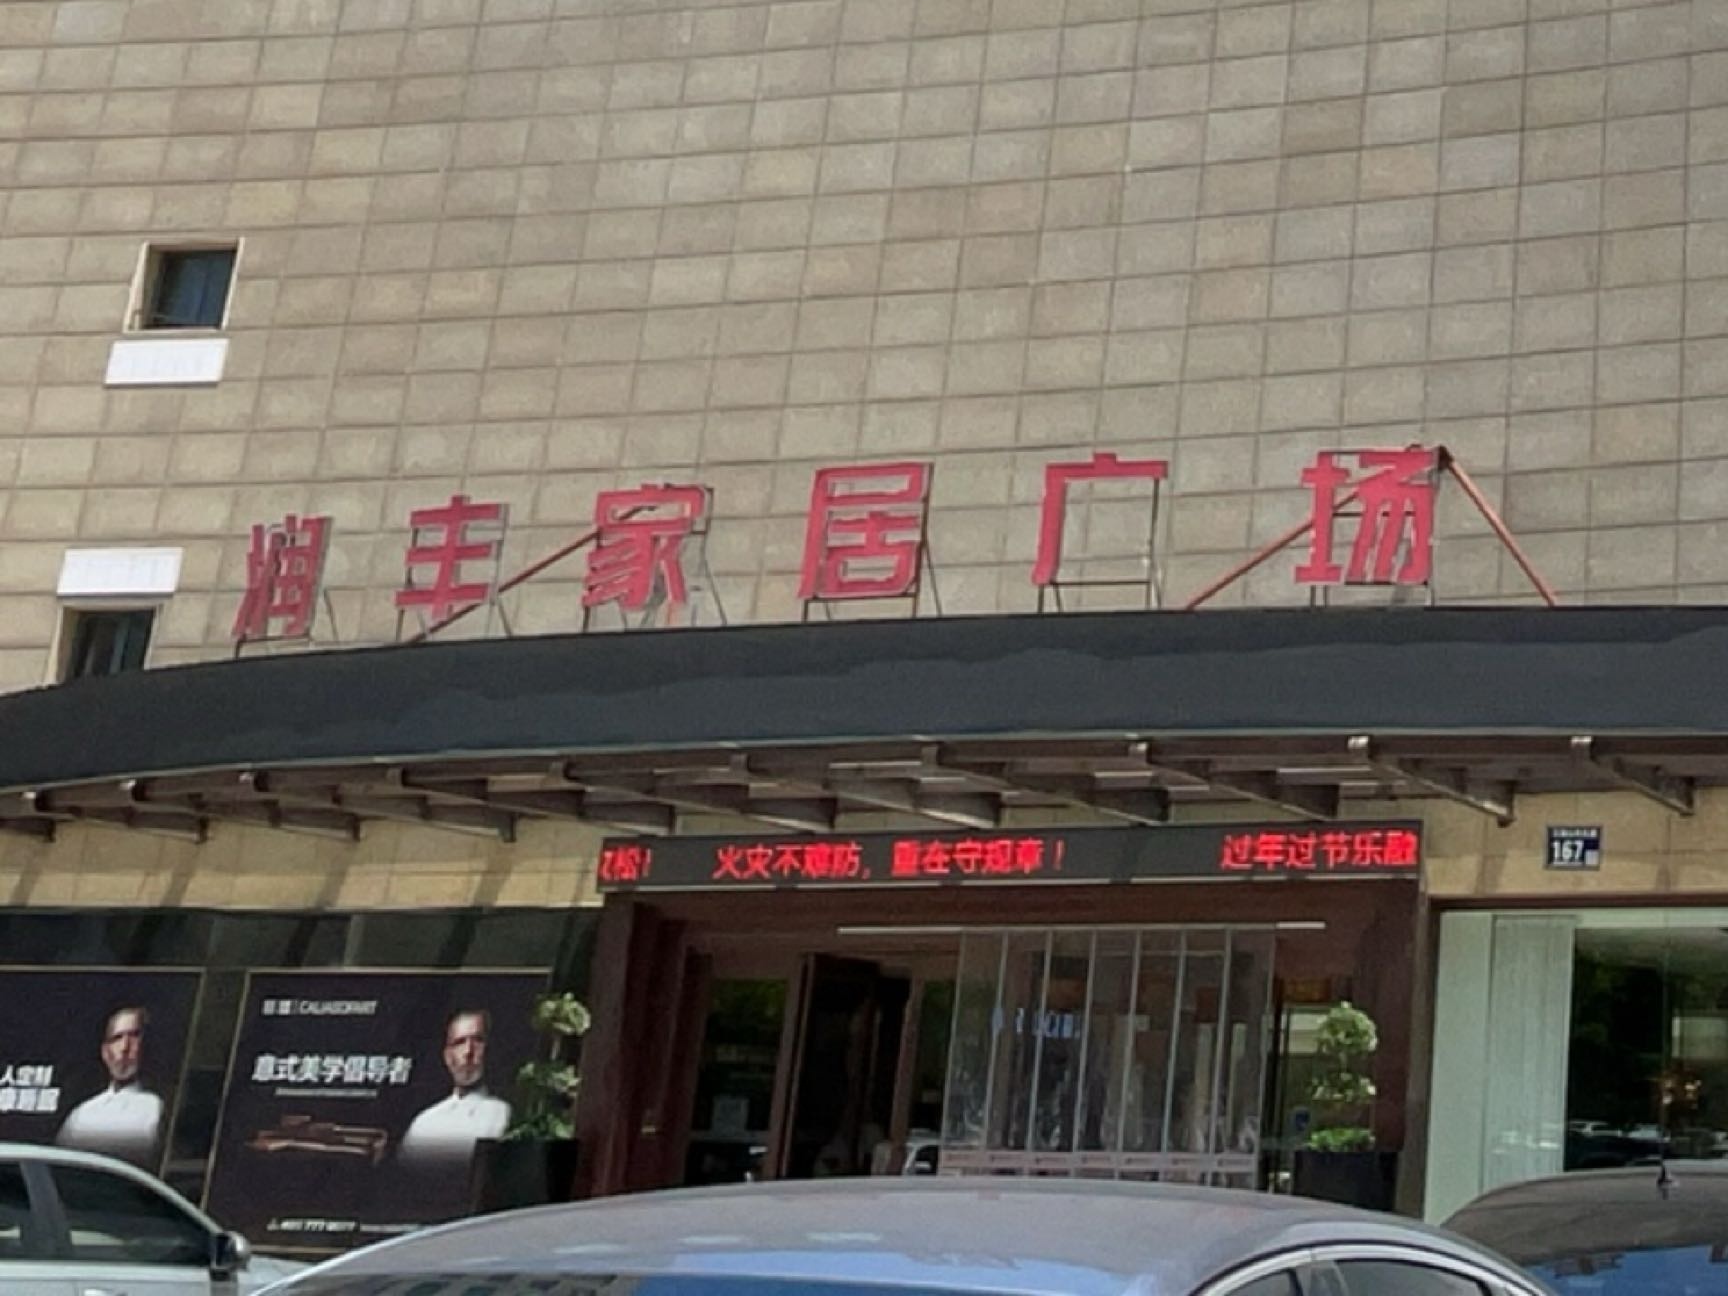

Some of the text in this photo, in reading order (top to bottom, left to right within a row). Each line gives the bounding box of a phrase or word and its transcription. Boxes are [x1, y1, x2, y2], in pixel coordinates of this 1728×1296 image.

[232, 448, 1435, 636] 润丰家居广场
[1553, 839, 1584, 861] 167
[251, 1053, 412, 1084] 意式美学倡导者
